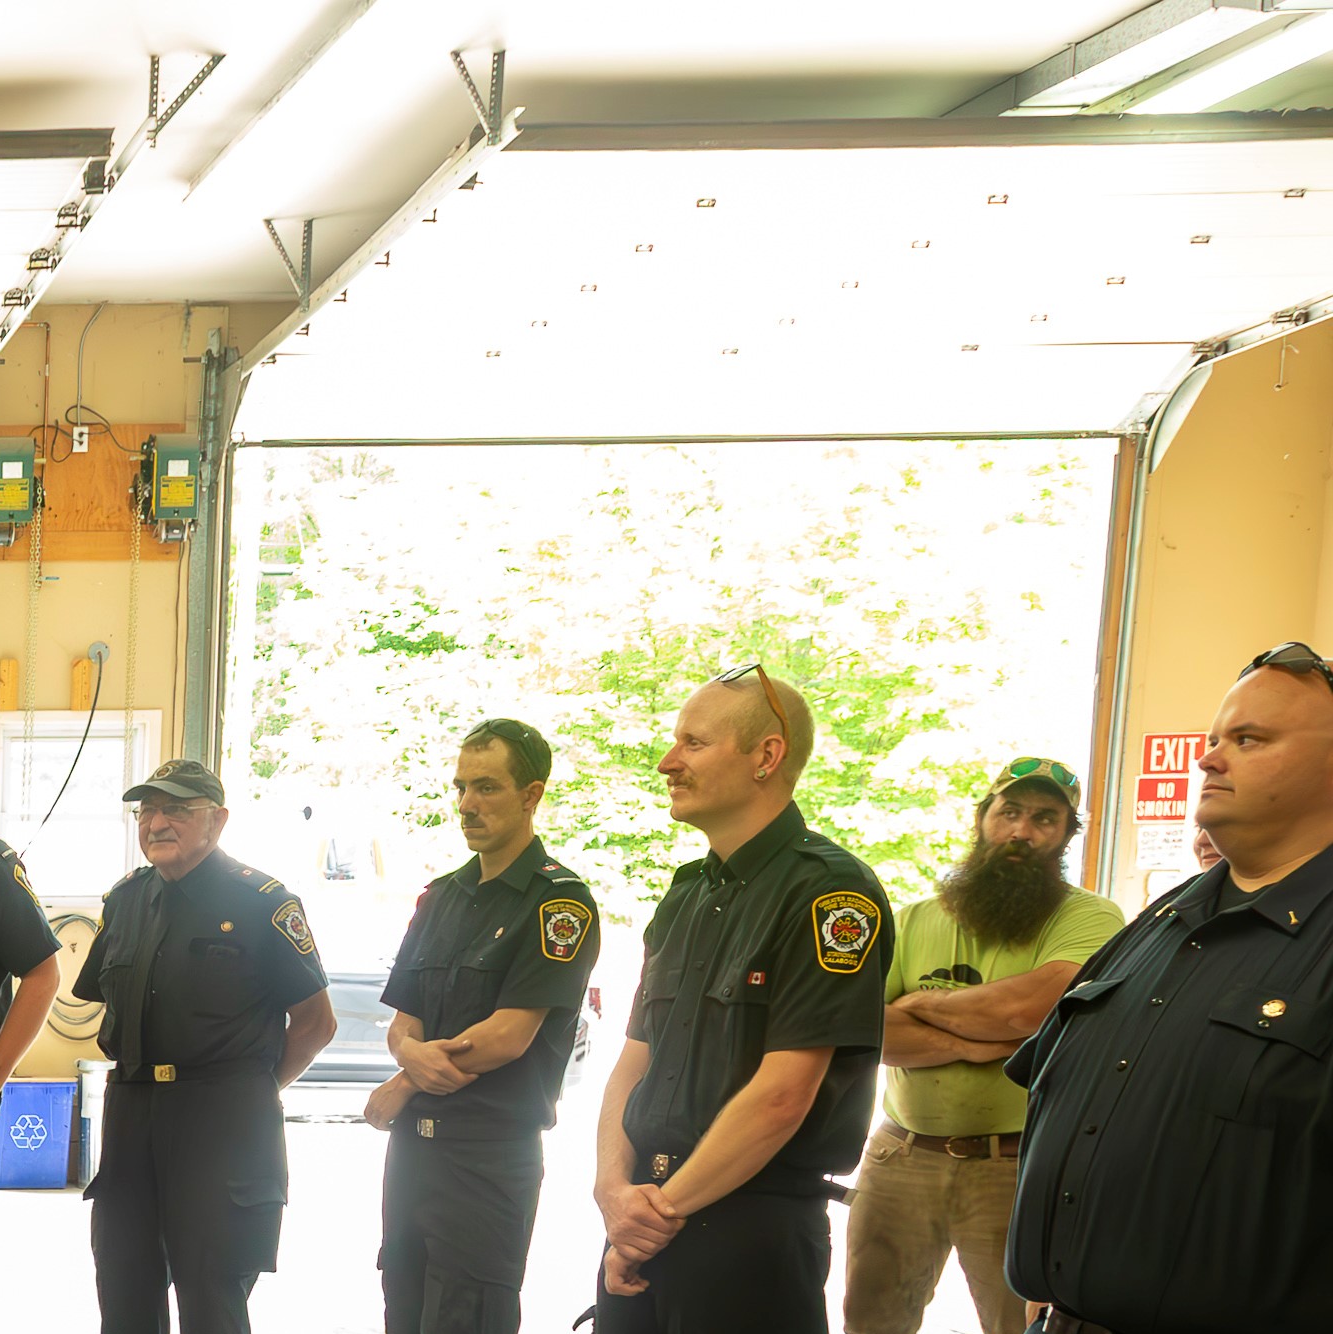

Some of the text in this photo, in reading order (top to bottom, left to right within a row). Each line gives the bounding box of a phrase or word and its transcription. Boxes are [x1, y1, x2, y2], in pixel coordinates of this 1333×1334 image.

[1149, 736, 1201, 772] EXIT
[1156, 781, 1176, 799] NO
[1136, 800, 1186, 817] SMOKIN
